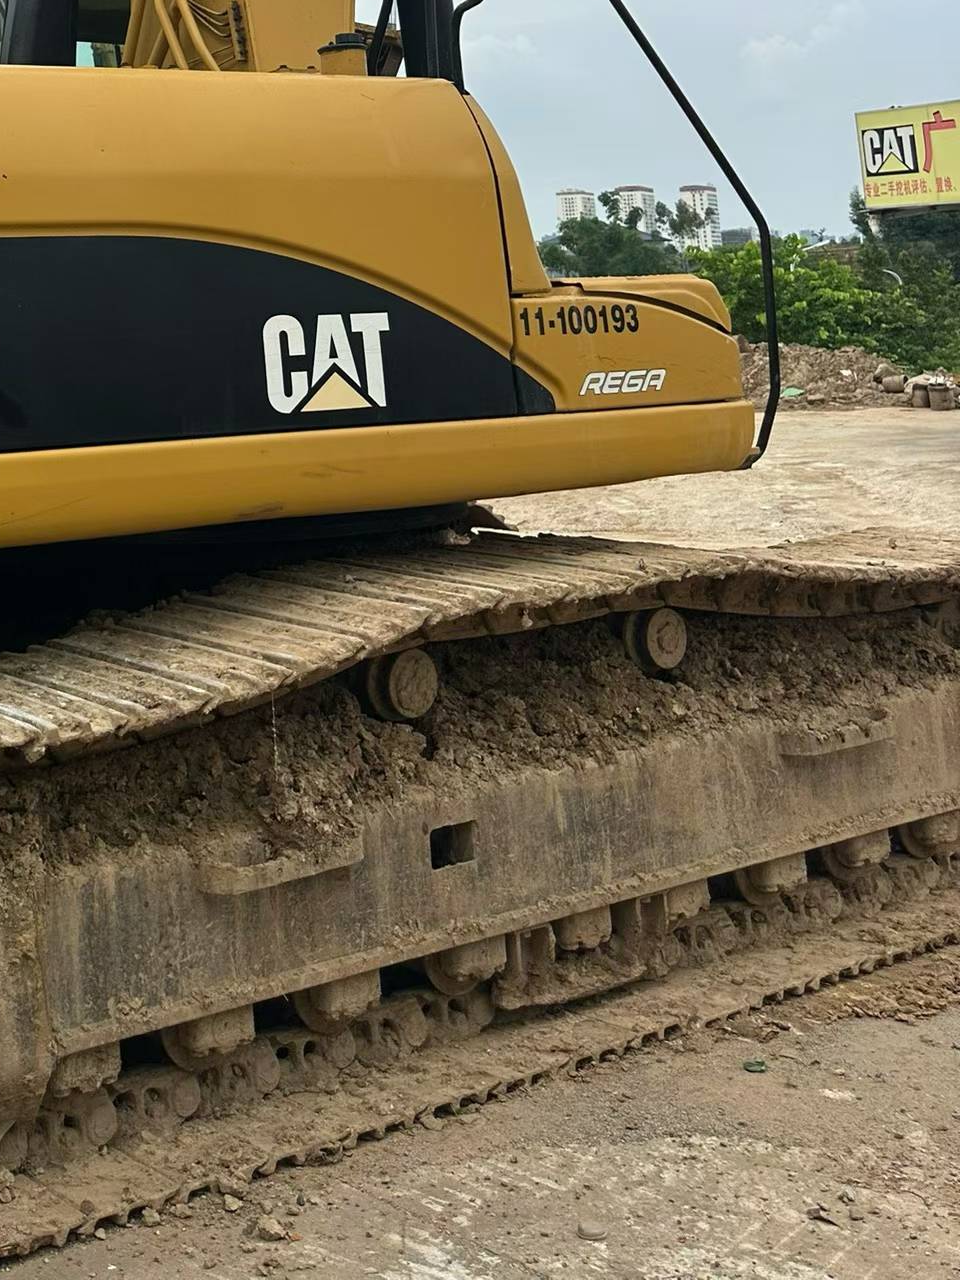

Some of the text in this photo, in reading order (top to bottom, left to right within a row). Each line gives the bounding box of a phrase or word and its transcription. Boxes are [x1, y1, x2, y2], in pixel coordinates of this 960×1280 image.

[863, 125, 915, 174] CAT
[262, 312, 390, 414] CAT
[578, 369, 667, 396] REGA
